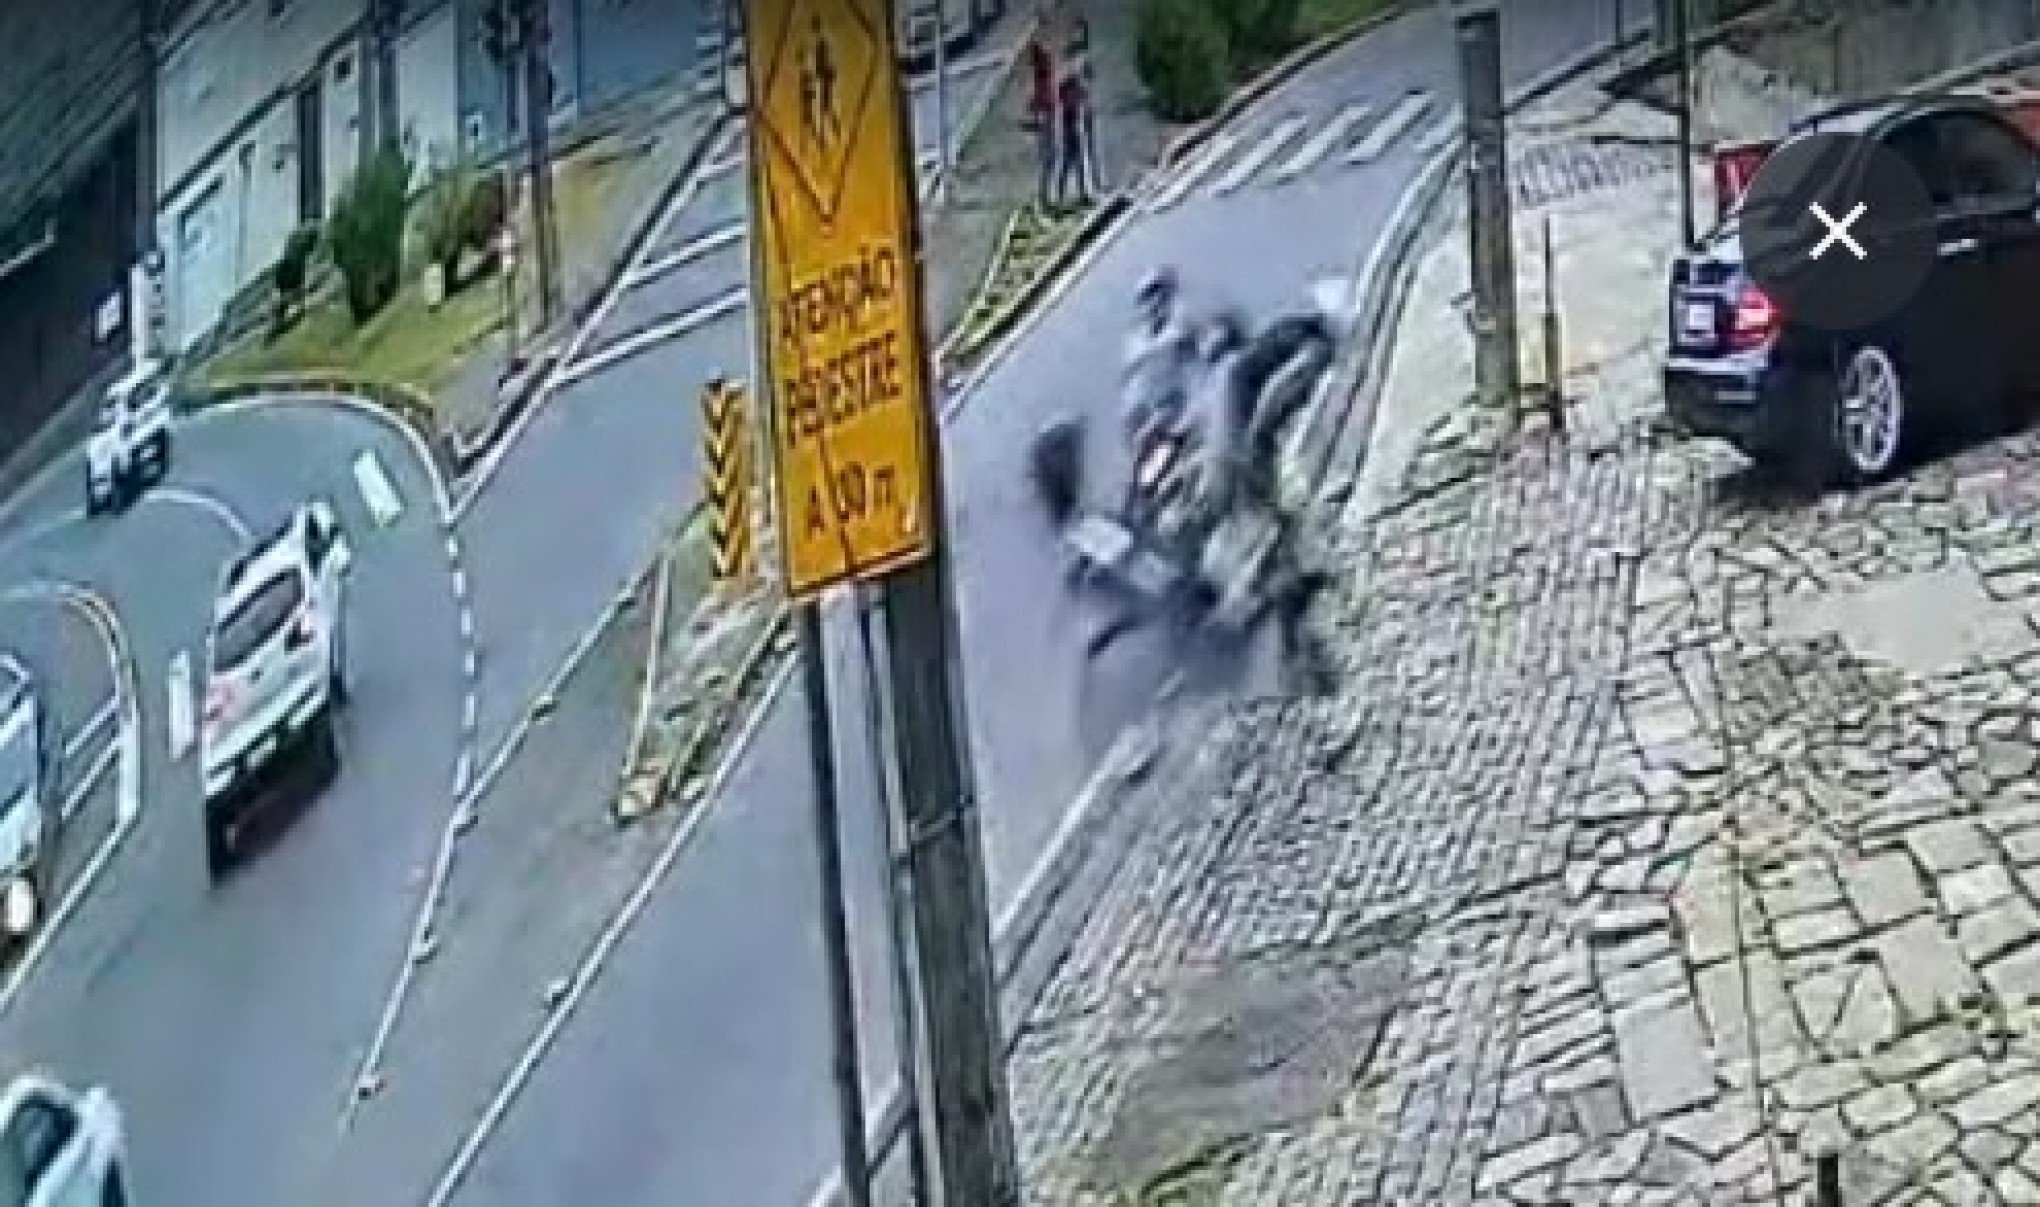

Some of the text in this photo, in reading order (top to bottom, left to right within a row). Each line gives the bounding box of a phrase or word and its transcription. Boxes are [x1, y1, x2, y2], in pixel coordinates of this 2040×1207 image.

[781, 246, 895, 345] ATENÇÃO
[787, 330, 899, 447] PEDESTRE
[806, 484, 826, 541] A
